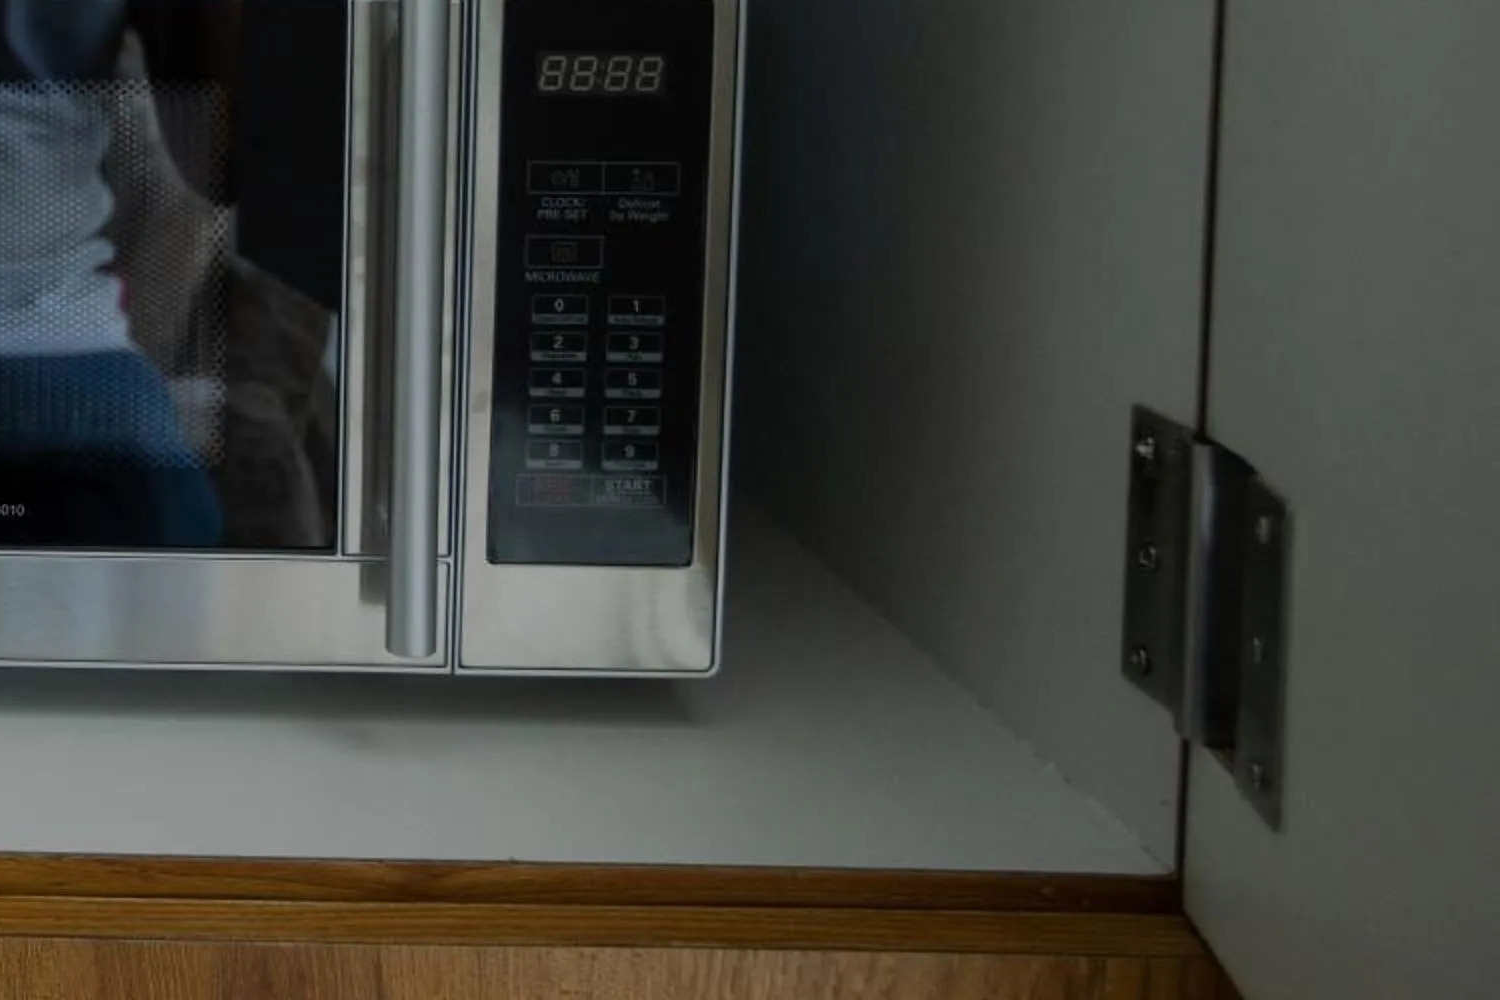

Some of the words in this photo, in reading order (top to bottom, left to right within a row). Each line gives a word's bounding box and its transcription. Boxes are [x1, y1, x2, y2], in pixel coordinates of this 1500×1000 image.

[554, 298, 565, 312] 0
[632, 299, 640, 312] 1
[553, 335, 564, 349] 2
[628, 336, 639, 350] 3
